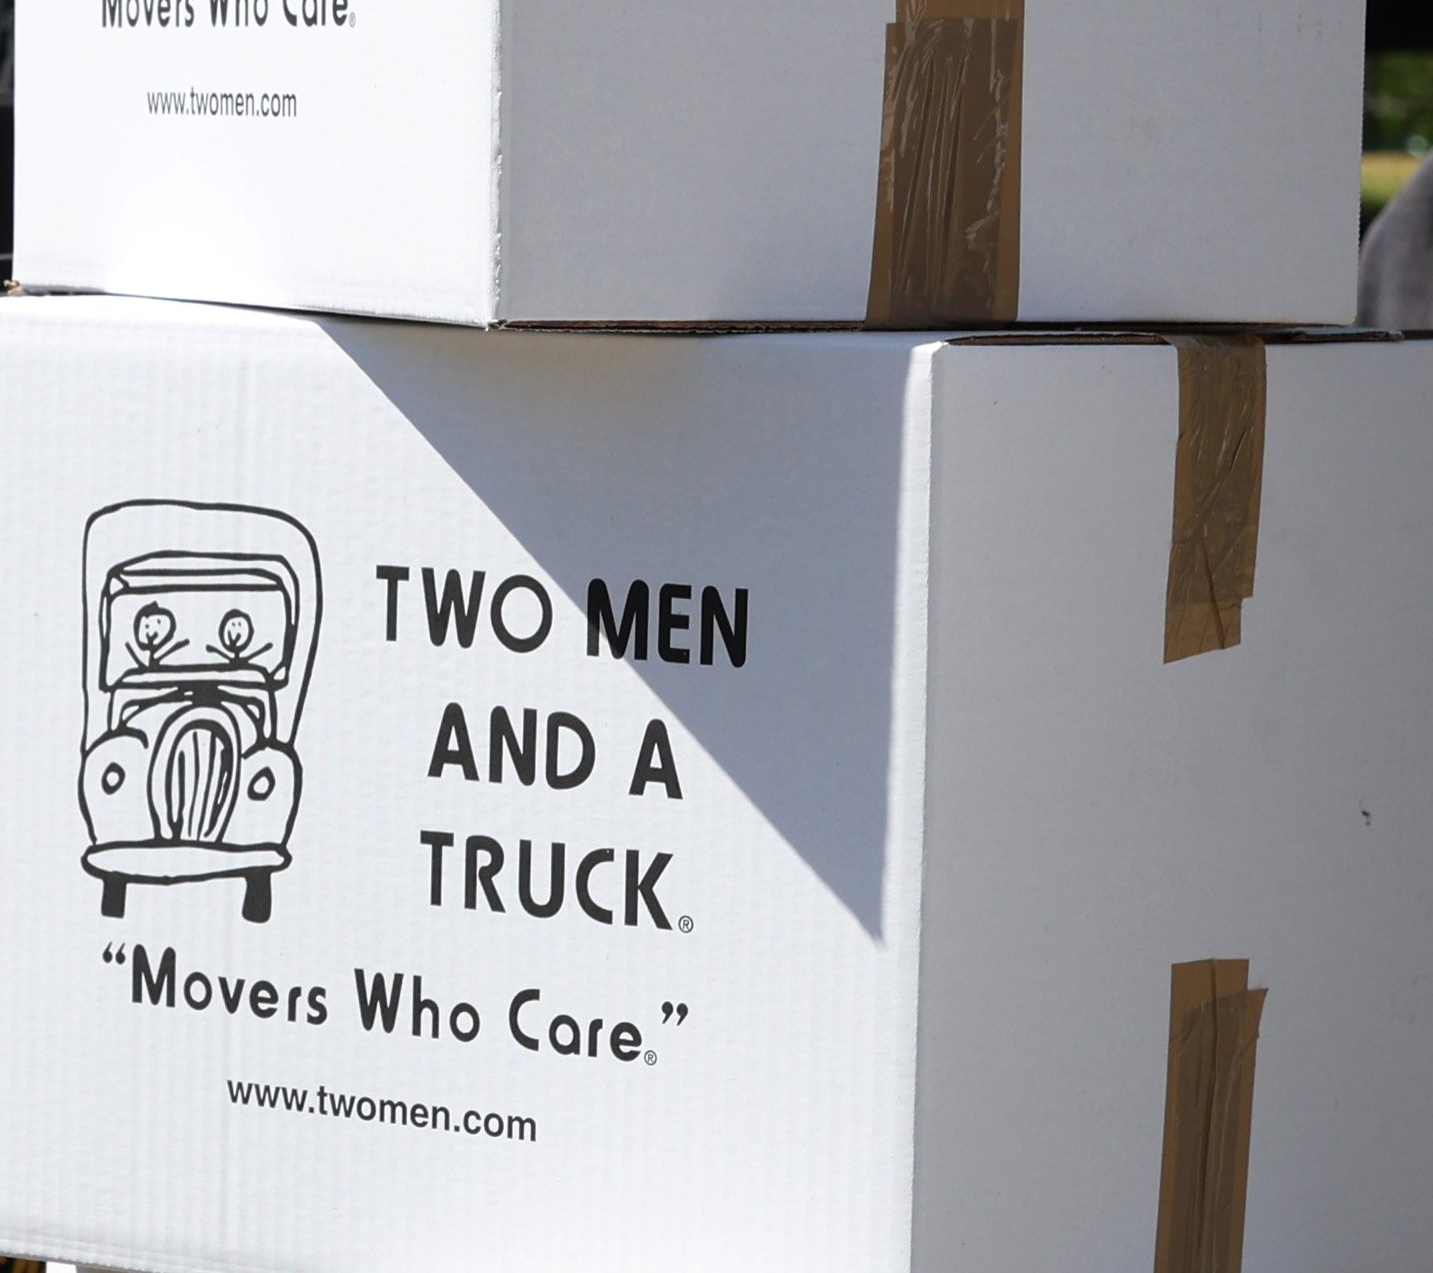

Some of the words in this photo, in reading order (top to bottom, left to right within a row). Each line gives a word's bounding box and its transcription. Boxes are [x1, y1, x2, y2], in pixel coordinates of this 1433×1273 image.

[147, 88, 297, 117] www.twomen.com
[376, 565, 552, 653] TWO
[586, 578, 748, 668] MEN
[428, 702, 595, 789] AND
[629, 719, 682, 799] A
[354, 968, 480, 1042] Who
[227, 1080, 536, 1142] www.twomen.com
